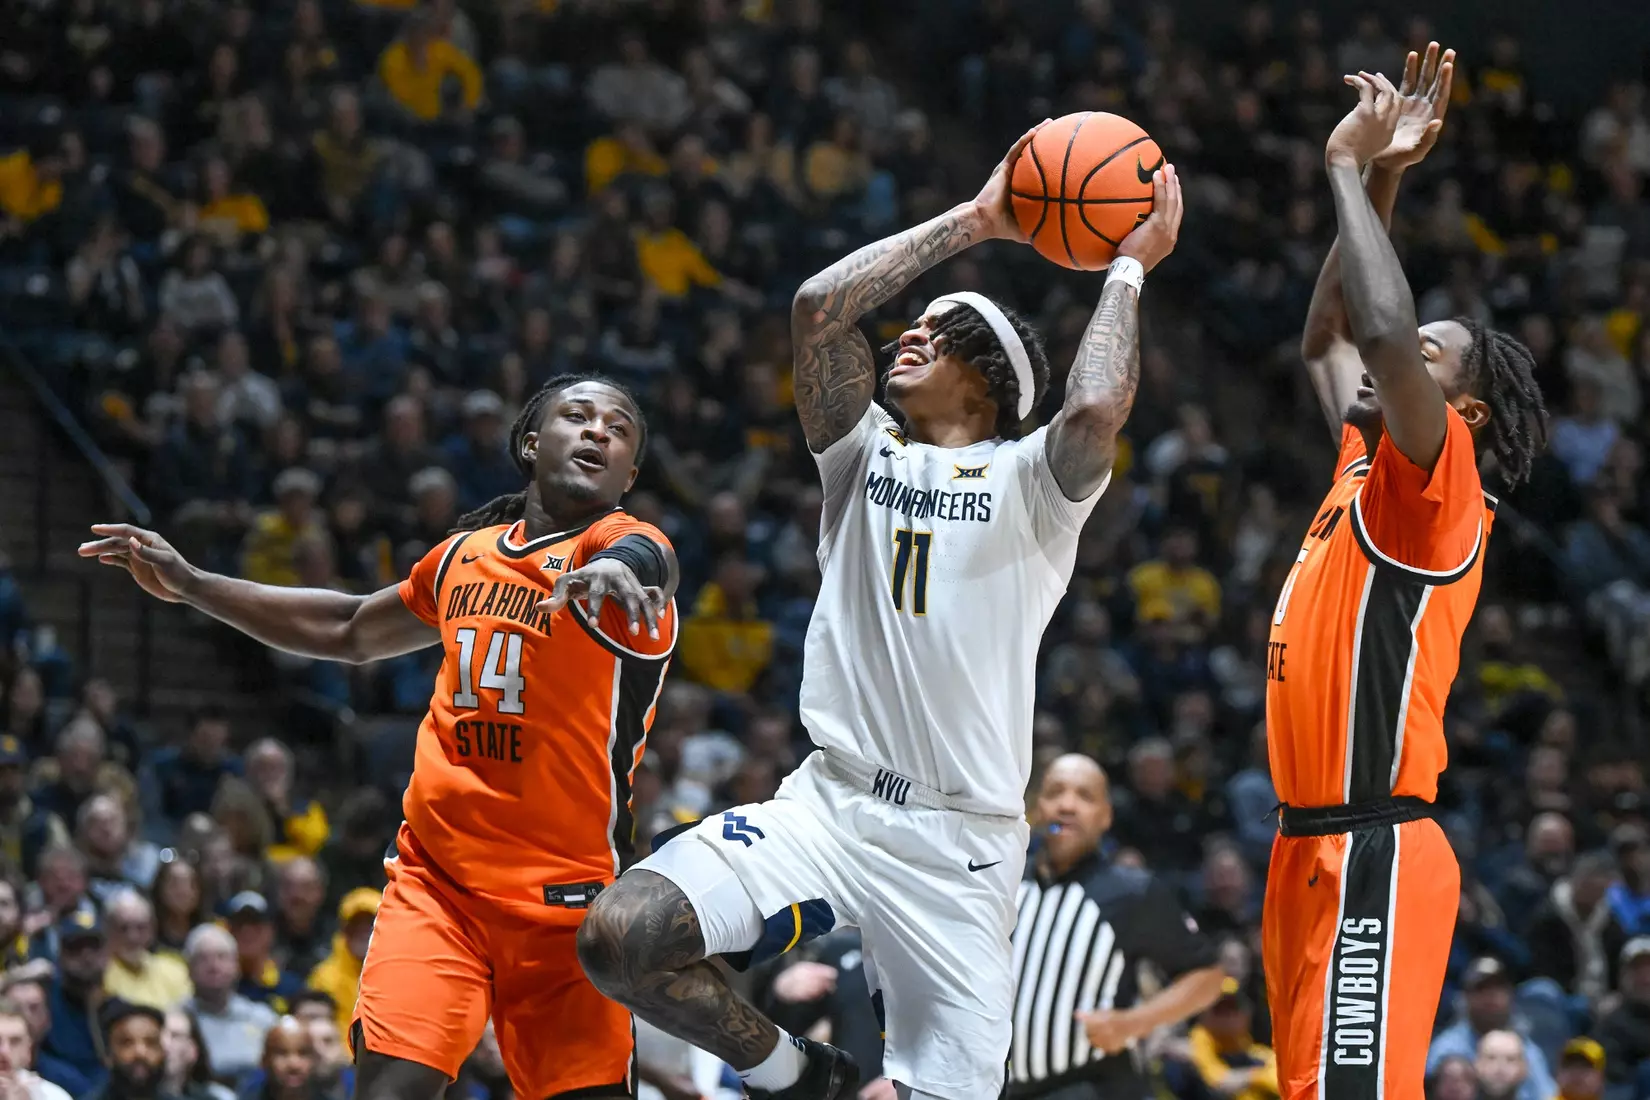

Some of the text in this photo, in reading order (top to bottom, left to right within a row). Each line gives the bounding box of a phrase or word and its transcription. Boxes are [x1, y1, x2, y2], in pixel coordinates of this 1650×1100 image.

[892, 528, 933, 616] 11
[445, 582, 552, 637] OKLAHOMA
[453, 627, 526, 714] 14
[455, 720, 523, 763] STATE
[871, 768, 911, 805] WVU
[1333, 917, 1382, 1066] COWBOYS
